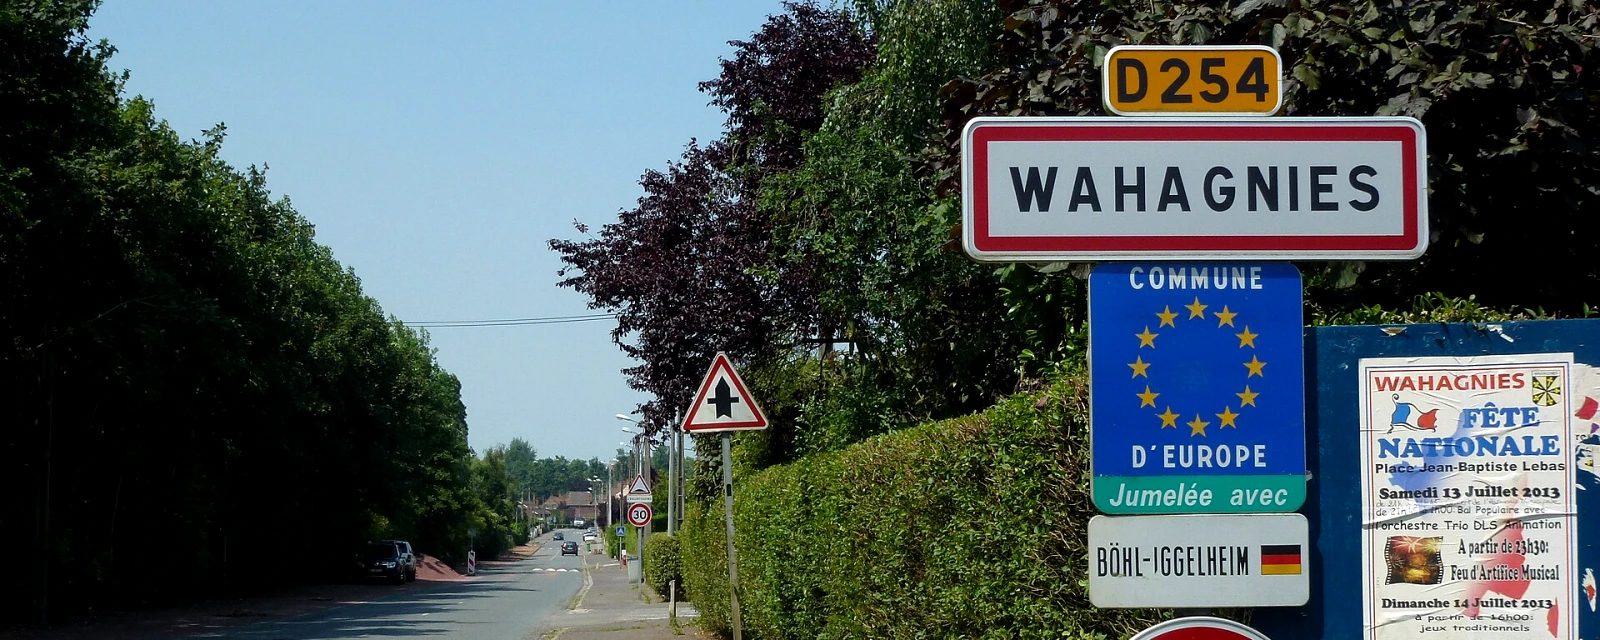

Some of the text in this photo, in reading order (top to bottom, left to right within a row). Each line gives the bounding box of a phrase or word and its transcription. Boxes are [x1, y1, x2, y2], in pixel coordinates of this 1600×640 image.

[1009, 164, 1380, 213] WAHAGNIES
[1129, 266, 1263, 290] COMMUNE
[1374, 373, 1525, 391] WAHAGNIES
[1463, 402, 1540, 428] FÊTE
[1378, 435, 1560, 458] NATIONALE
[1132, 444, 1267, 468] D'EUROPE
[1376, 461, 1565, 474] Place Jean-Baptiste Lebas
[1109, 482, 1288, 507] Jumelée avec
[1379, 486, 1560, 500] Samedi 13 Juillet 2013
[633, 510, 647, 520] 30
[1375, 508, 1387, 516] de
[1457, 506, 1471, 514] Bal
[1475, 506, 1519, 516] Populaire
[1444, 520, 1469, 530] Trio
[1473, 520, 1497, 530] DLS
[1505, 519, 1562, 529] Animation
[1458, 538, 1549, 557] A partir de 23h30:
[1097, 543, 1249, 576] BÖHL-IGGELHEIM
[1450, 564, 1559, 580] Feu d'Artifice Musical
[1382, 597, 1552, 609] Dimanche 14 Juillet 2013
[1428, 614, 1464, 622] partir
[1420, 625, 1446, 633] jeux
